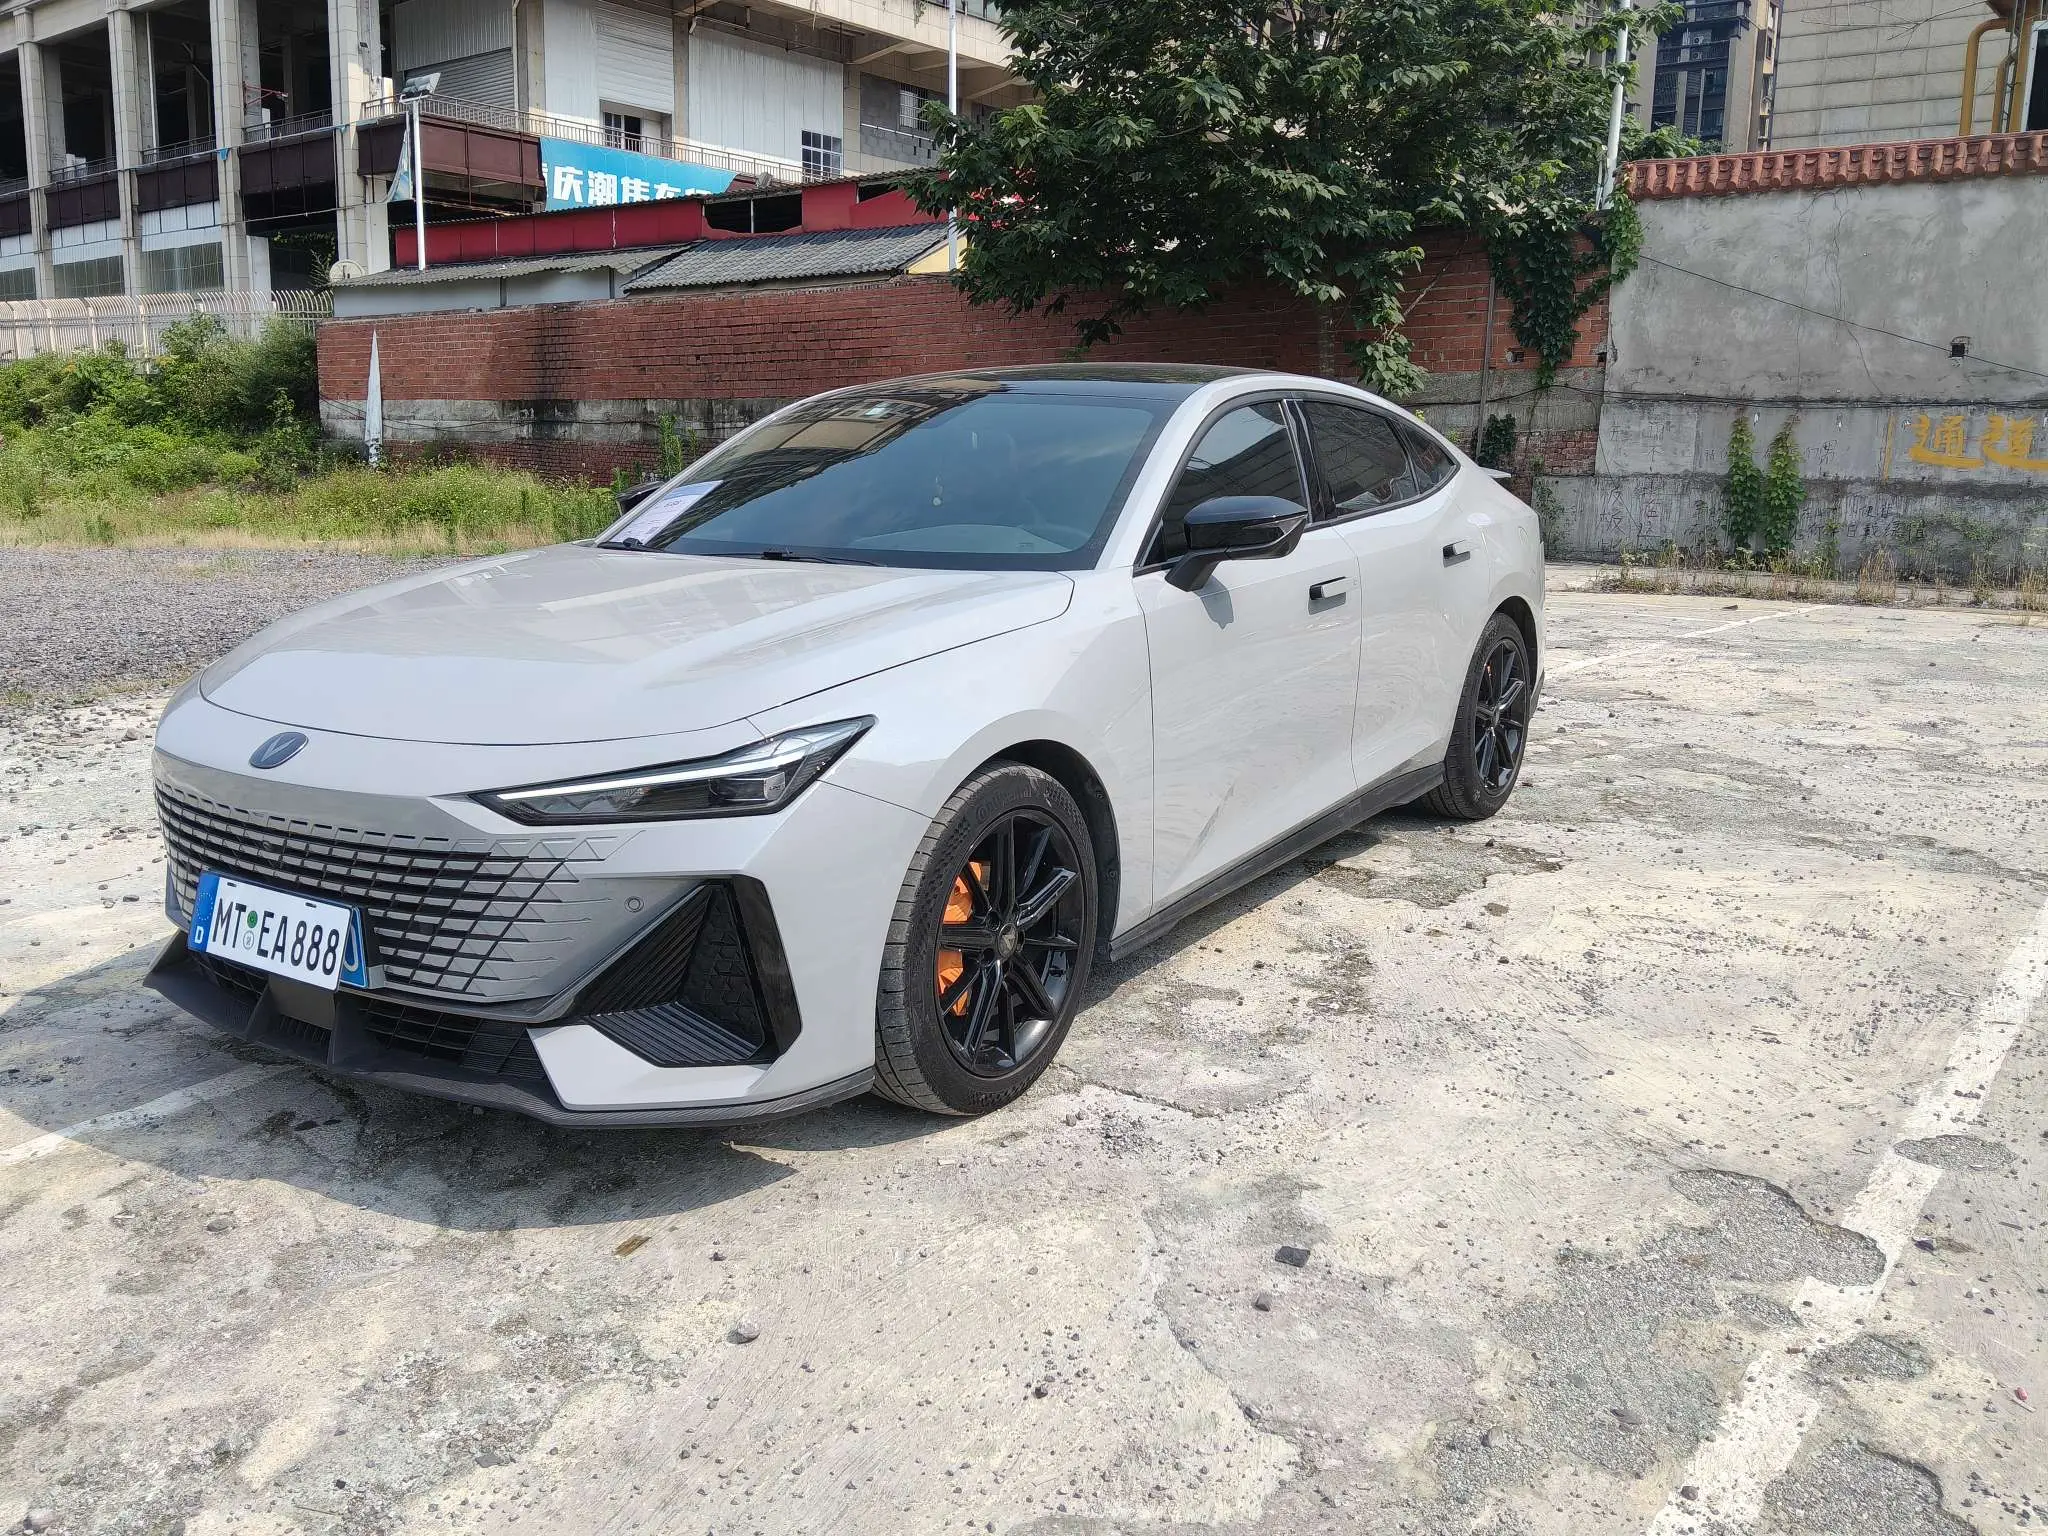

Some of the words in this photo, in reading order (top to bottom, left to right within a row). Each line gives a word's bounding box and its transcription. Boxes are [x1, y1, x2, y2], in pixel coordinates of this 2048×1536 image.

[194, 925, 204, 944] D
[211, 898, 247, 949] MT
[256, 910, 340, 976] EA888
